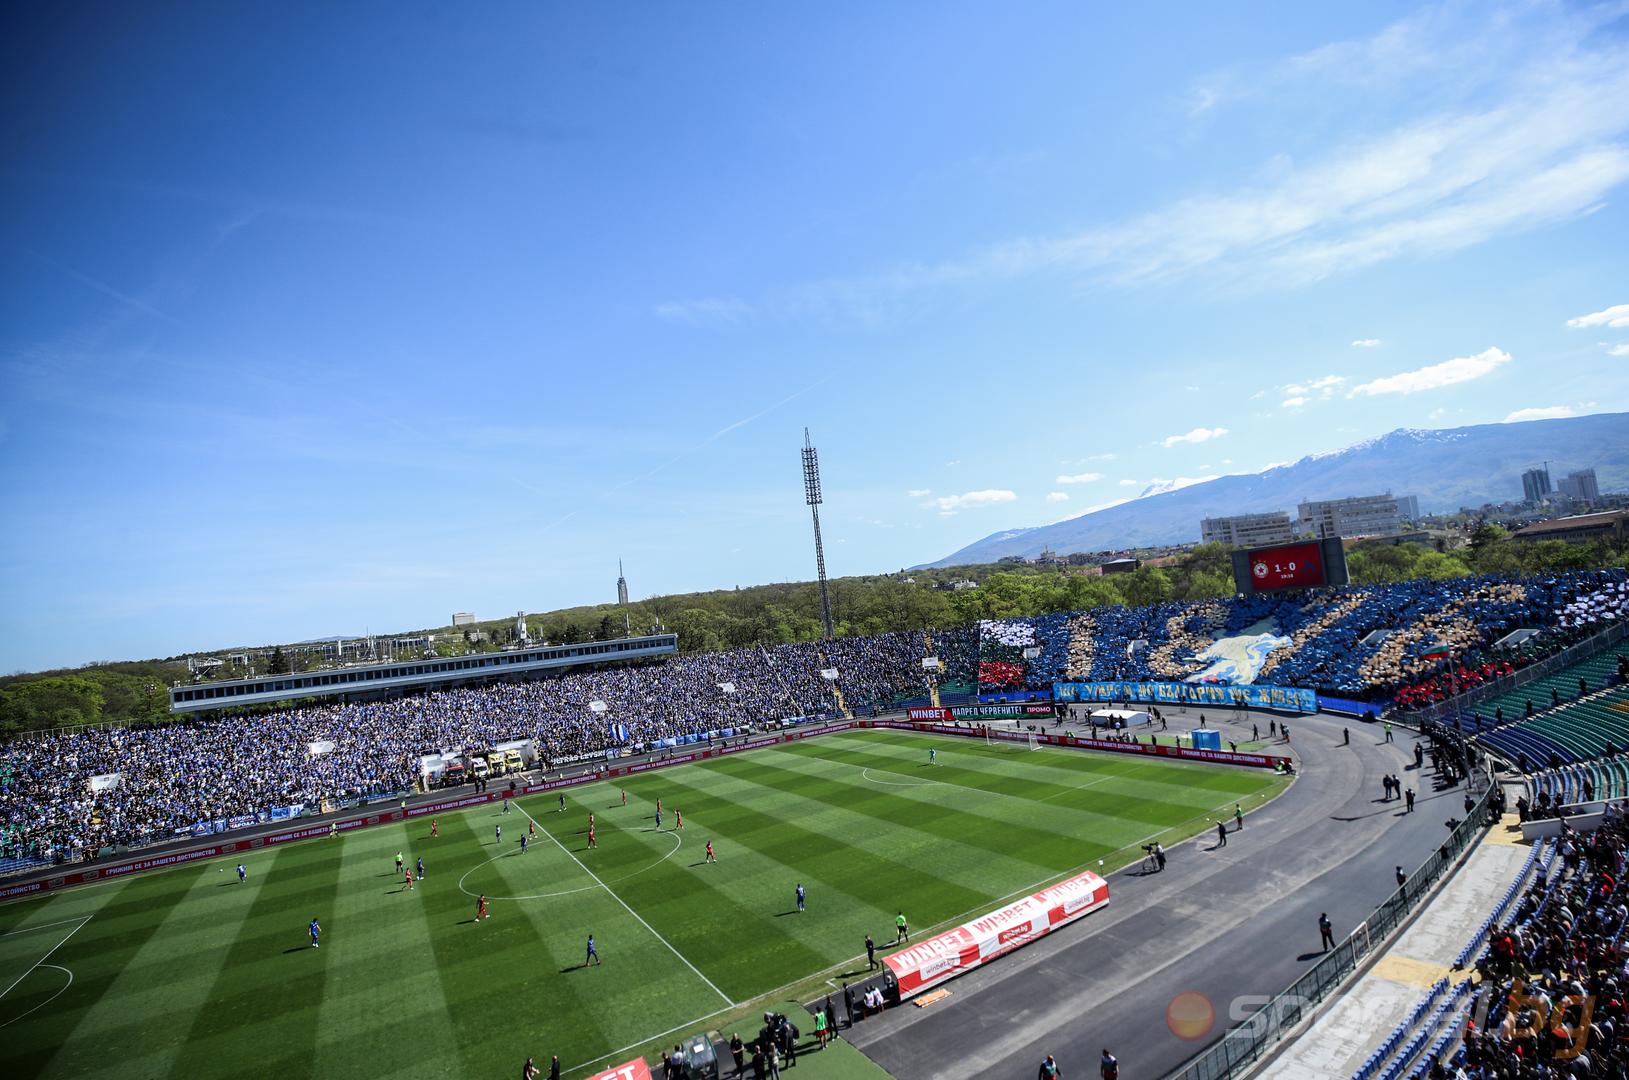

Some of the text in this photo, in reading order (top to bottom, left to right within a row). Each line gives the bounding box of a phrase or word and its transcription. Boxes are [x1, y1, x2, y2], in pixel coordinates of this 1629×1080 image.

[910, 709, 946, 719] WINBET
[952, 705, 1022, 717] НАПРЕД ЧЕРВЕНИТЕ!
[106, 865, 134, 875] ГРИЖИМ
[152, 856, 176, 866] ВАШЕТО
[176, 849, 216, 862] ДОСТОЙНСТВО
[1039, 873, 1095, 904] WINBET
[892, 930, 966, 969] WINBET
